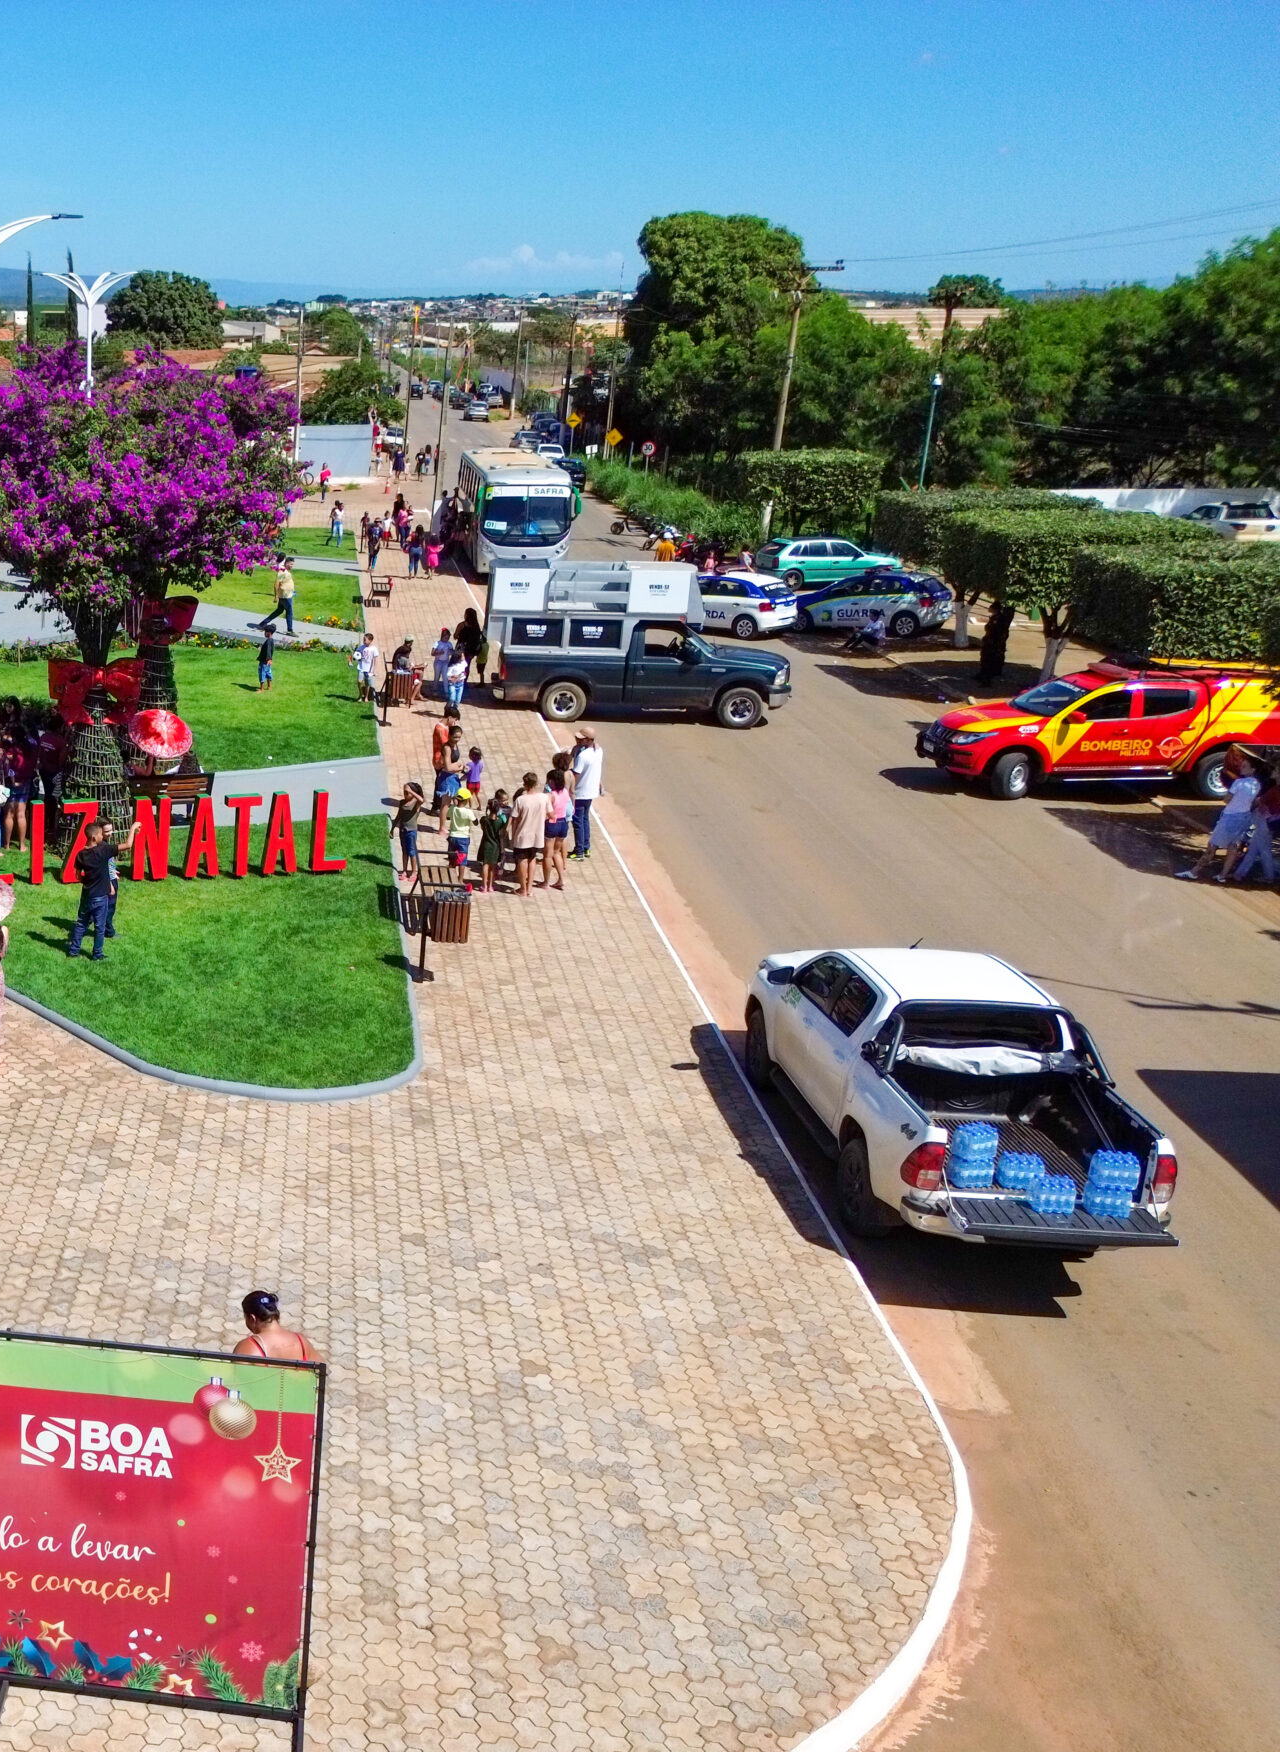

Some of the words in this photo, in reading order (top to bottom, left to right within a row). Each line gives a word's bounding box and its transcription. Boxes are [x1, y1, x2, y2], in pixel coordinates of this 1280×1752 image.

[644, 443, 653, 451] 30
[533, 487, 565, 496] SAFRA
[704, 610, 726, 619] RDA
[836, 608, 886, 618] GUARA
[1080, 739, 1153, 752] BOMBEIRO
[1120, 749, 1150, 757] MILITAR
[132, 788, 347, 881] NATAL
[80, 1419, 174, 1459] BOA
[80, 1451, 173, 1479] SAFRA
[37, 1534, 63, 1553] a
[70, 1523, 156, 1561] levar
[30, 1571, 171, 1606] corações!
